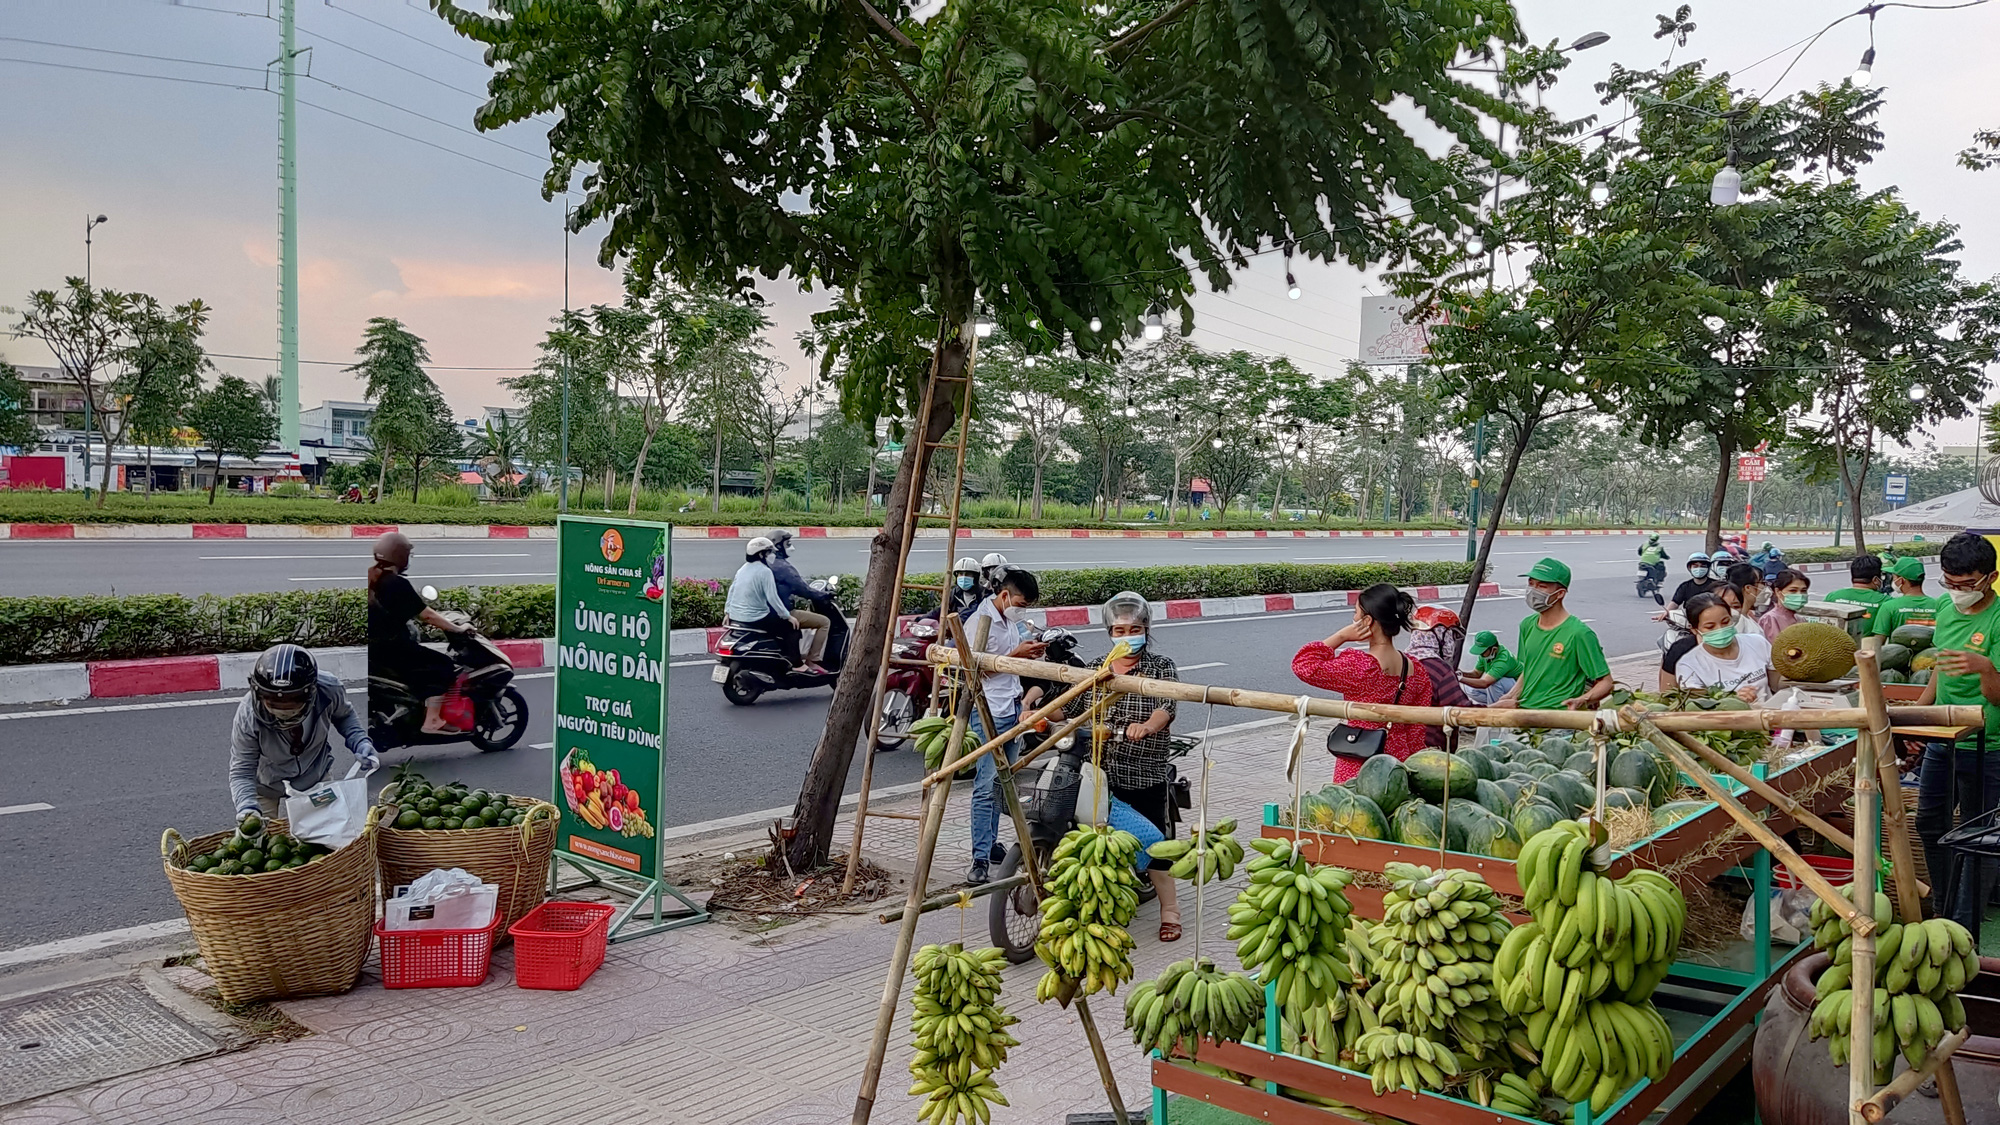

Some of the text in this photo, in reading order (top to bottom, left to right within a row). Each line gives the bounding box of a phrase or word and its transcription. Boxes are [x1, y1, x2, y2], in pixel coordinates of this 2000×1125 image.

[584, 563, 642, 578] NÔNG SẢN CHIA SẺ
[574, 600, 651, 647] ỦNG HỘ
[560, 641, 662, 684] NÔNG DÂN
[584, 695, 633, 719] TRỢ GIÁ
[557, 713, 661, 750] NGƯỜI TIÊU DÙNG
